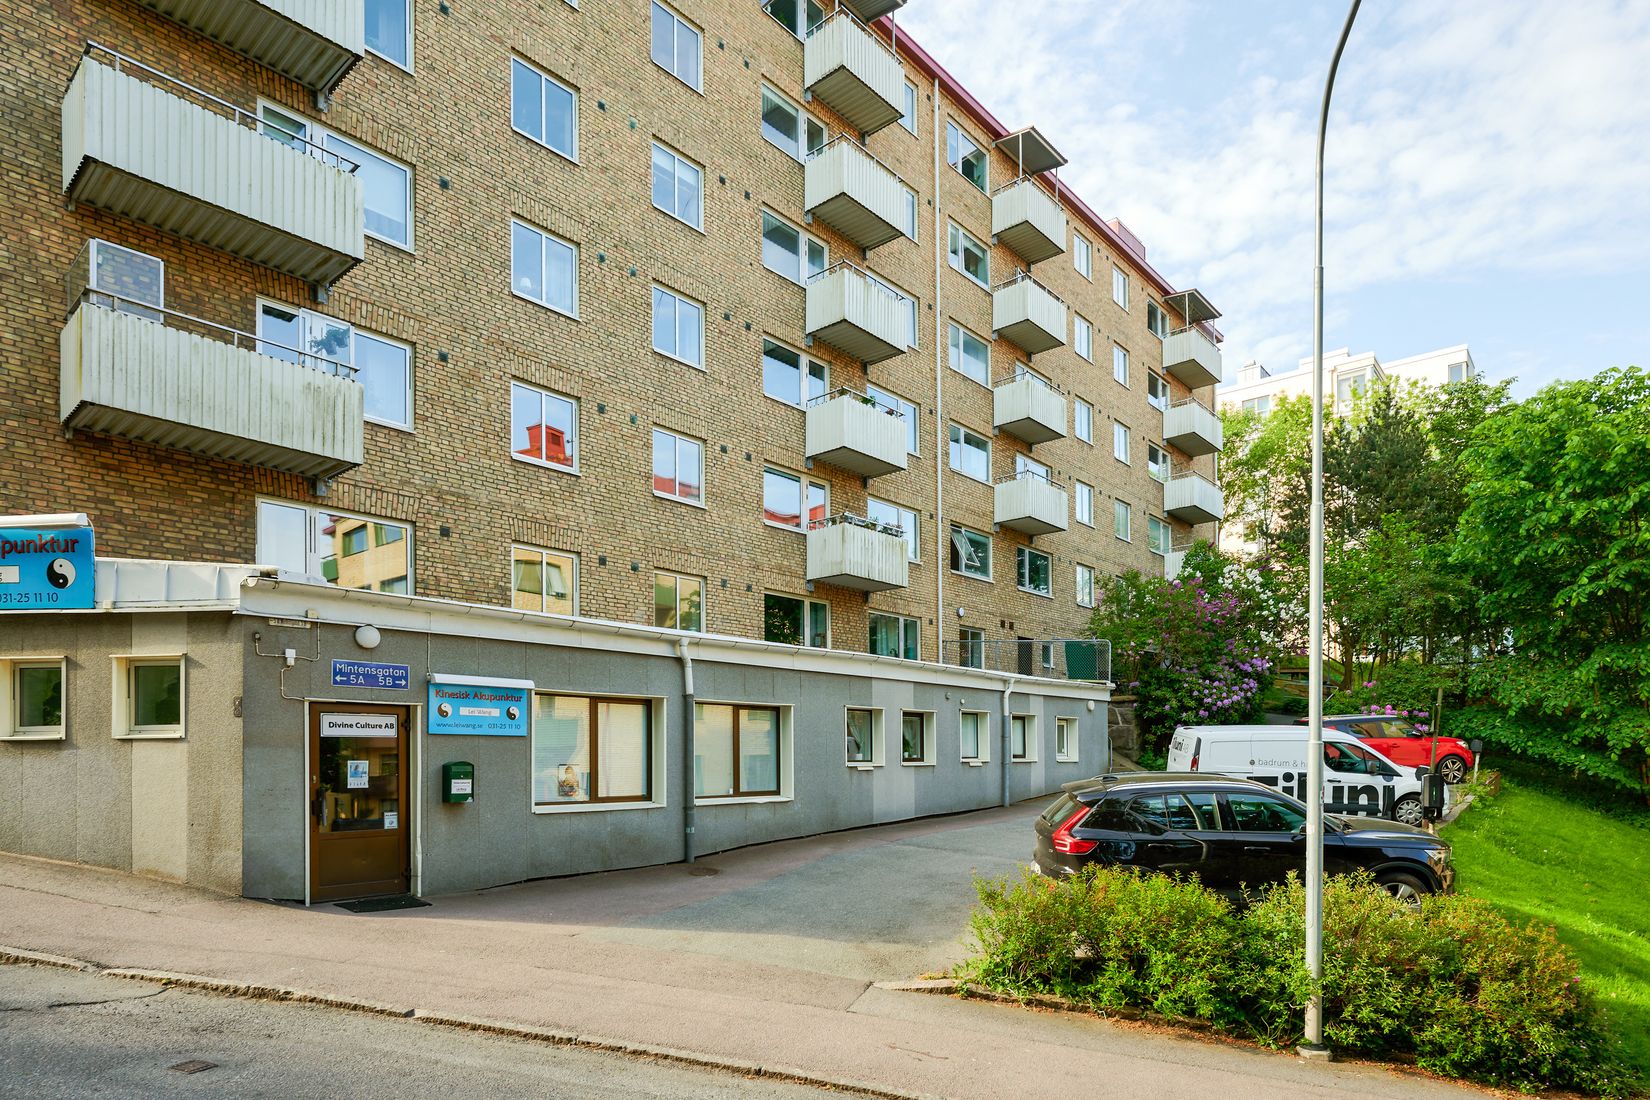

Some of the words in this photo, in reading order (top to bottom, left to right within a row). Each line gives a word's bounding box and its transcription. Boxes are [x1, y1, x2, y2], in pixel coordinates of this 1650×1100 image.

[0, 592, 30, 603] 31-25
[34, 592, 42, 603] 11
[47, 592, 59, 603] 10
[336, 664, 406, 677] Mintensgatan
[350, 675, 365, 684] 5A
[378, 676, 393, 686] 5B
[435, 689, 470, 700] Kinesisk
[473, 692, 523, 703] Akupunktur
[328, 721, 354, 729] Divine
[355, 722, 383, 730] Culture
[384, 722, 395, 730] AB
[436, 722, 483, 730] www.leiwang.se
[1258, 758, 1291, 767] badrum
[1292, 759, 1298, 768] &
